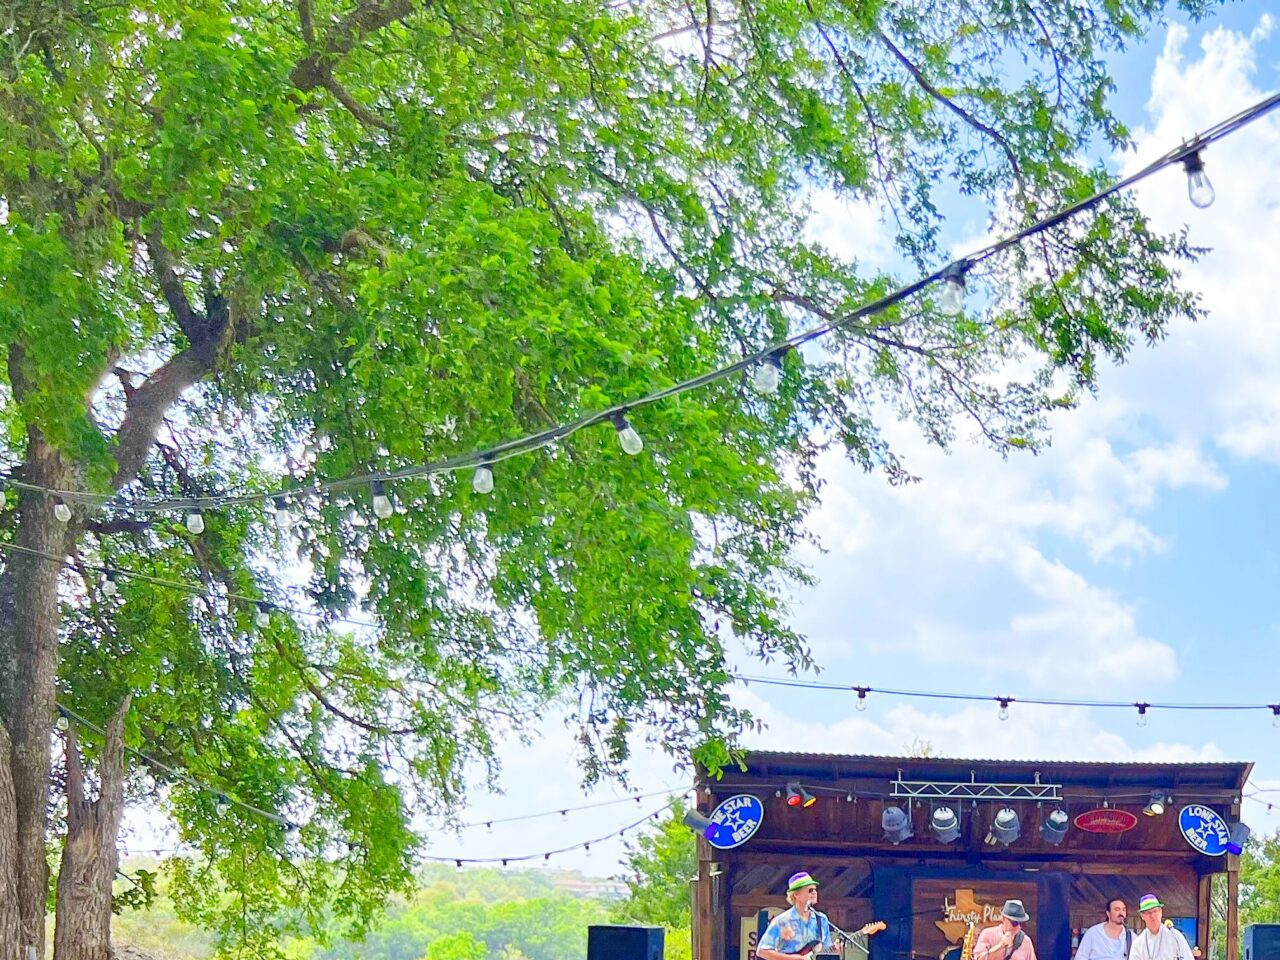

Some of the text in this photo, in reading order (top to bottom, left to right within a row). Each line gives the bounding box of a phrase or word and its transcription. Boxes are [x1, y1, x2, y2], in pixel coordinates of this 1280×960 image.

[723, 797, 752, 814] STAR
[732, 818, 757, 843] BEER
[1188, 807, 1228, 845] LONE STAR
[1185, 827, 1208, 850] BEER
